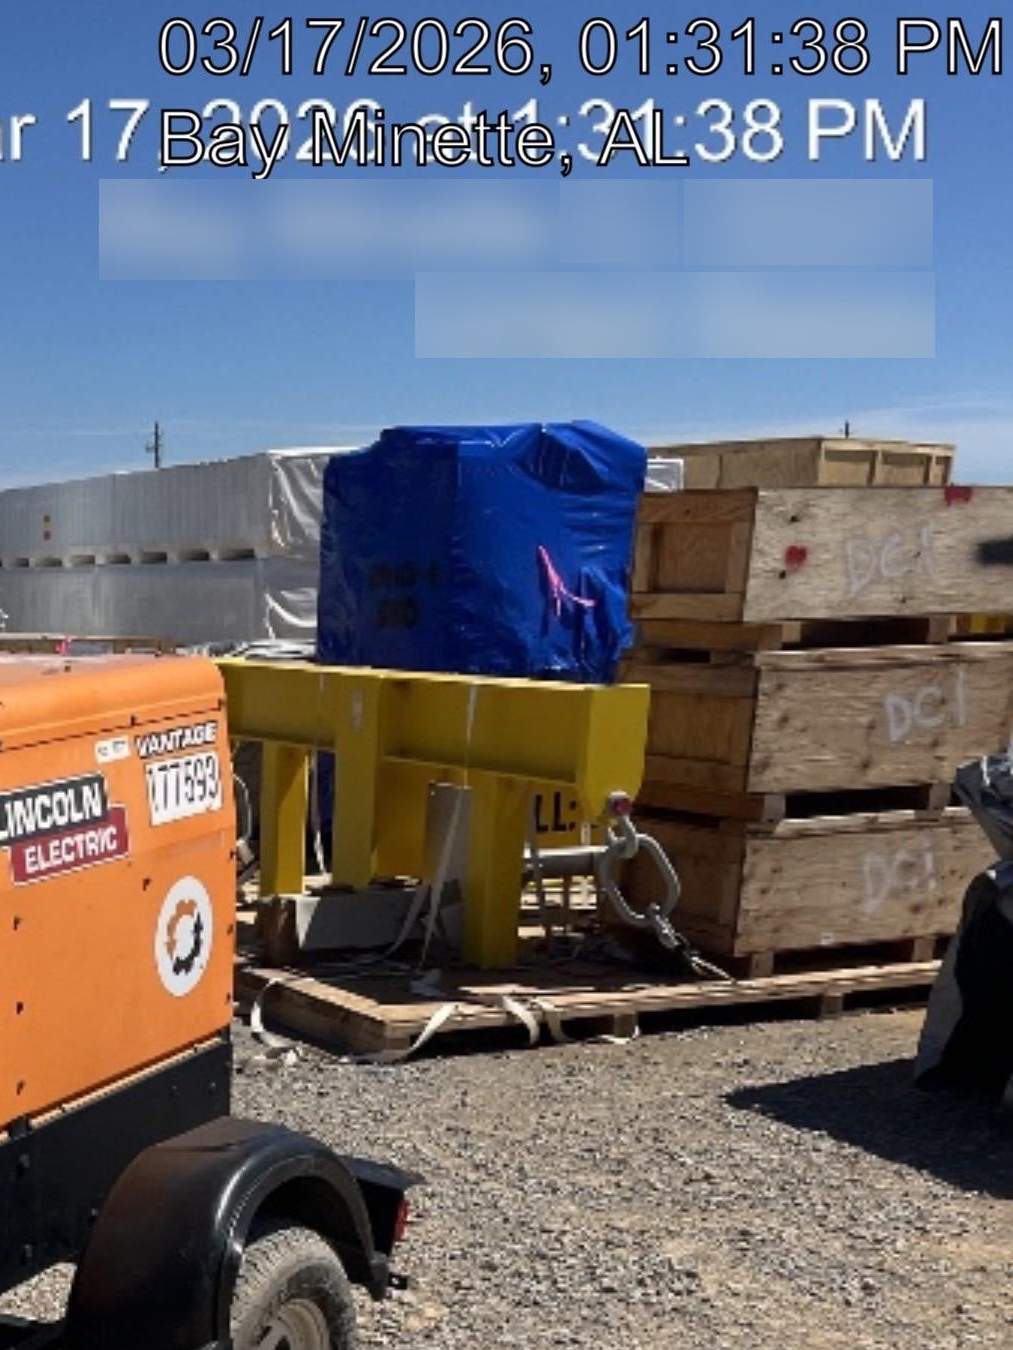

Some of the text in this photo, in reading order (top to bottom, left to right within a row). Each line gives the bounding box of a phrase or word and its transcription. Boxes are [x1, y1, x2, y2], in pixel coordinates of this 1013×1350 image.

[135, 720, 218, 759] VANTAGE
[147, 755, 220, 814] 177593
[24, 824, 118, 874] ELECTRIC
